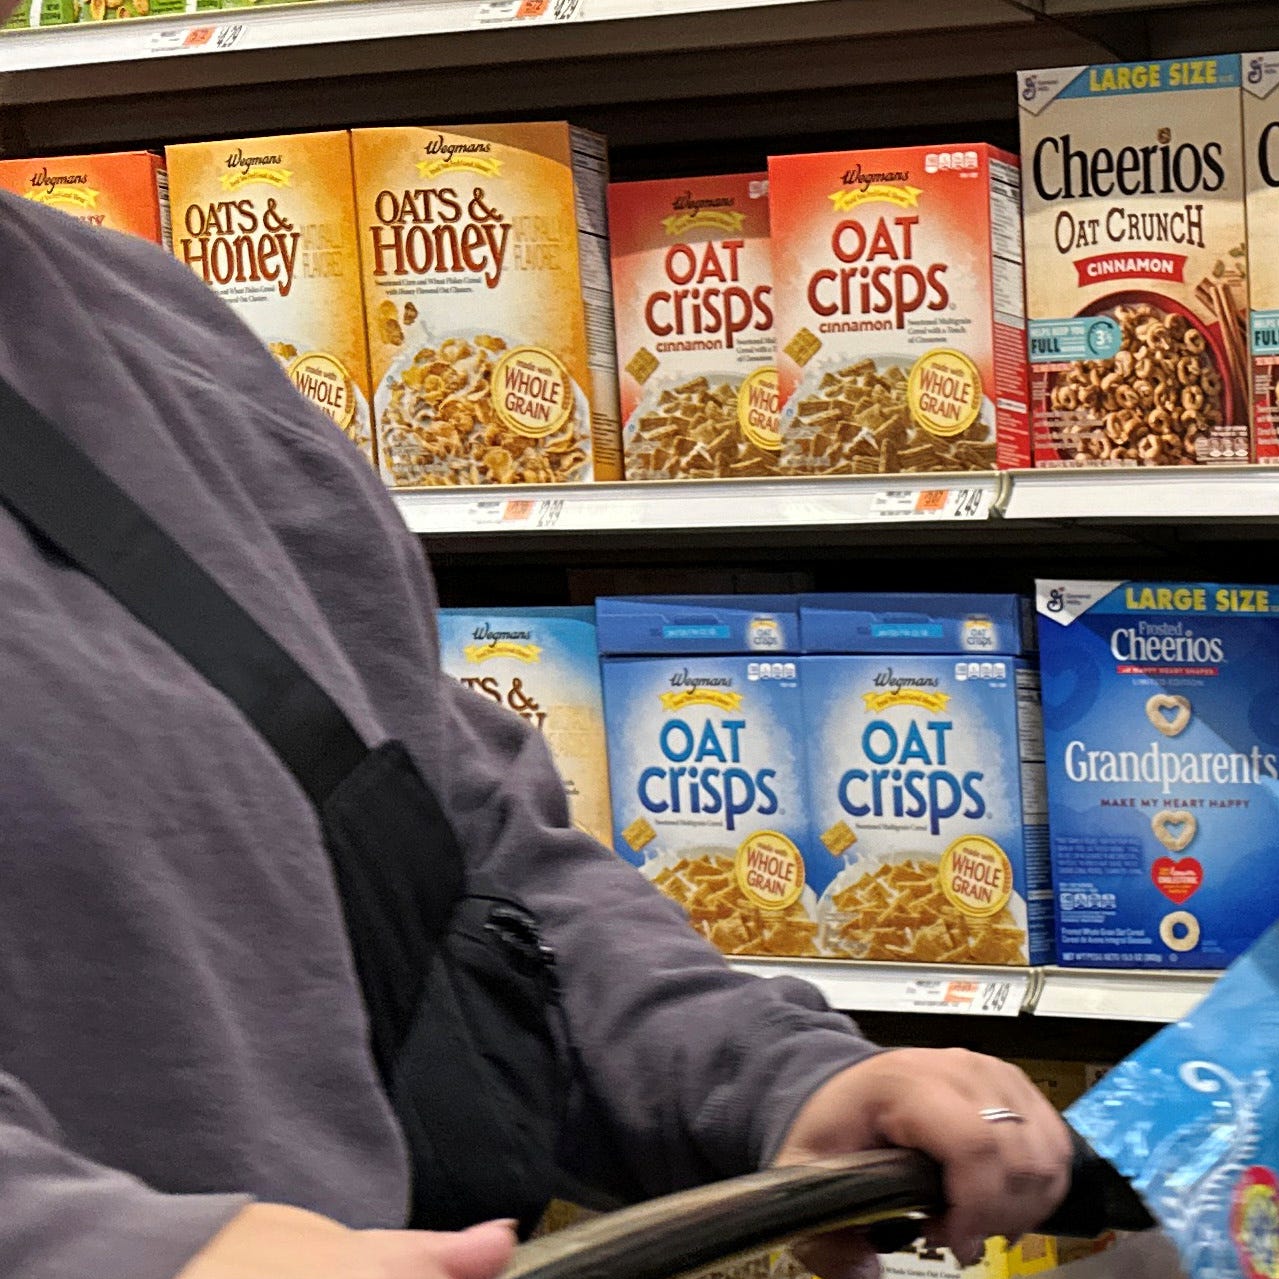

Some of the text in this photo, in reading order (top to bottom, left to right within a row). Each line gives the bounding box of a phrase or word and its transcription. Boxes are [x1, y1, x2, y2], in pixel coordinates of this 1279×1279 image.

[1089, 60, 1217, 91] LARGE SIZE
[840, 165, 910, 191] Wegmans
[1032, 127, 1226, 201] Cheerios
[184, 197, 294, 235] OATS &
[375, 188, 501, 224] OATS &
[832, 216, 919, 263] OAT
[1055, 204, 1206, 253] OAT CRUNCH
[181, 233, 301, 296] Honey
[371, 223, 511, 287] Honey
[1086, 260, 1174, 277] CINNAMON
[807, 263, 949, 329] crisps
[819, 320, 893, 334] cinnamon
[656, 339, 723, 353] cinnamon
[919, 374, 972, 405] WHOLE
[505, 394, 550, 423] GRAIN
[920, 394, 961, 421] GRAIN
[1125, 587, 1269, 612] LARGE SIZE
[471, 623, 533, 647] Wegmans
[1139, 621, 1182, 636] Frosted
[670, 668, 734, 695] Wegmans
[659, 718, 746, 764] OAT
[1065, 740, 1279, 794] Grandparents
[837, 769, 985, 835] crisps
[745, 849, 794, 878] WHOLE
[746, 873, 786, 897] GRAIN
